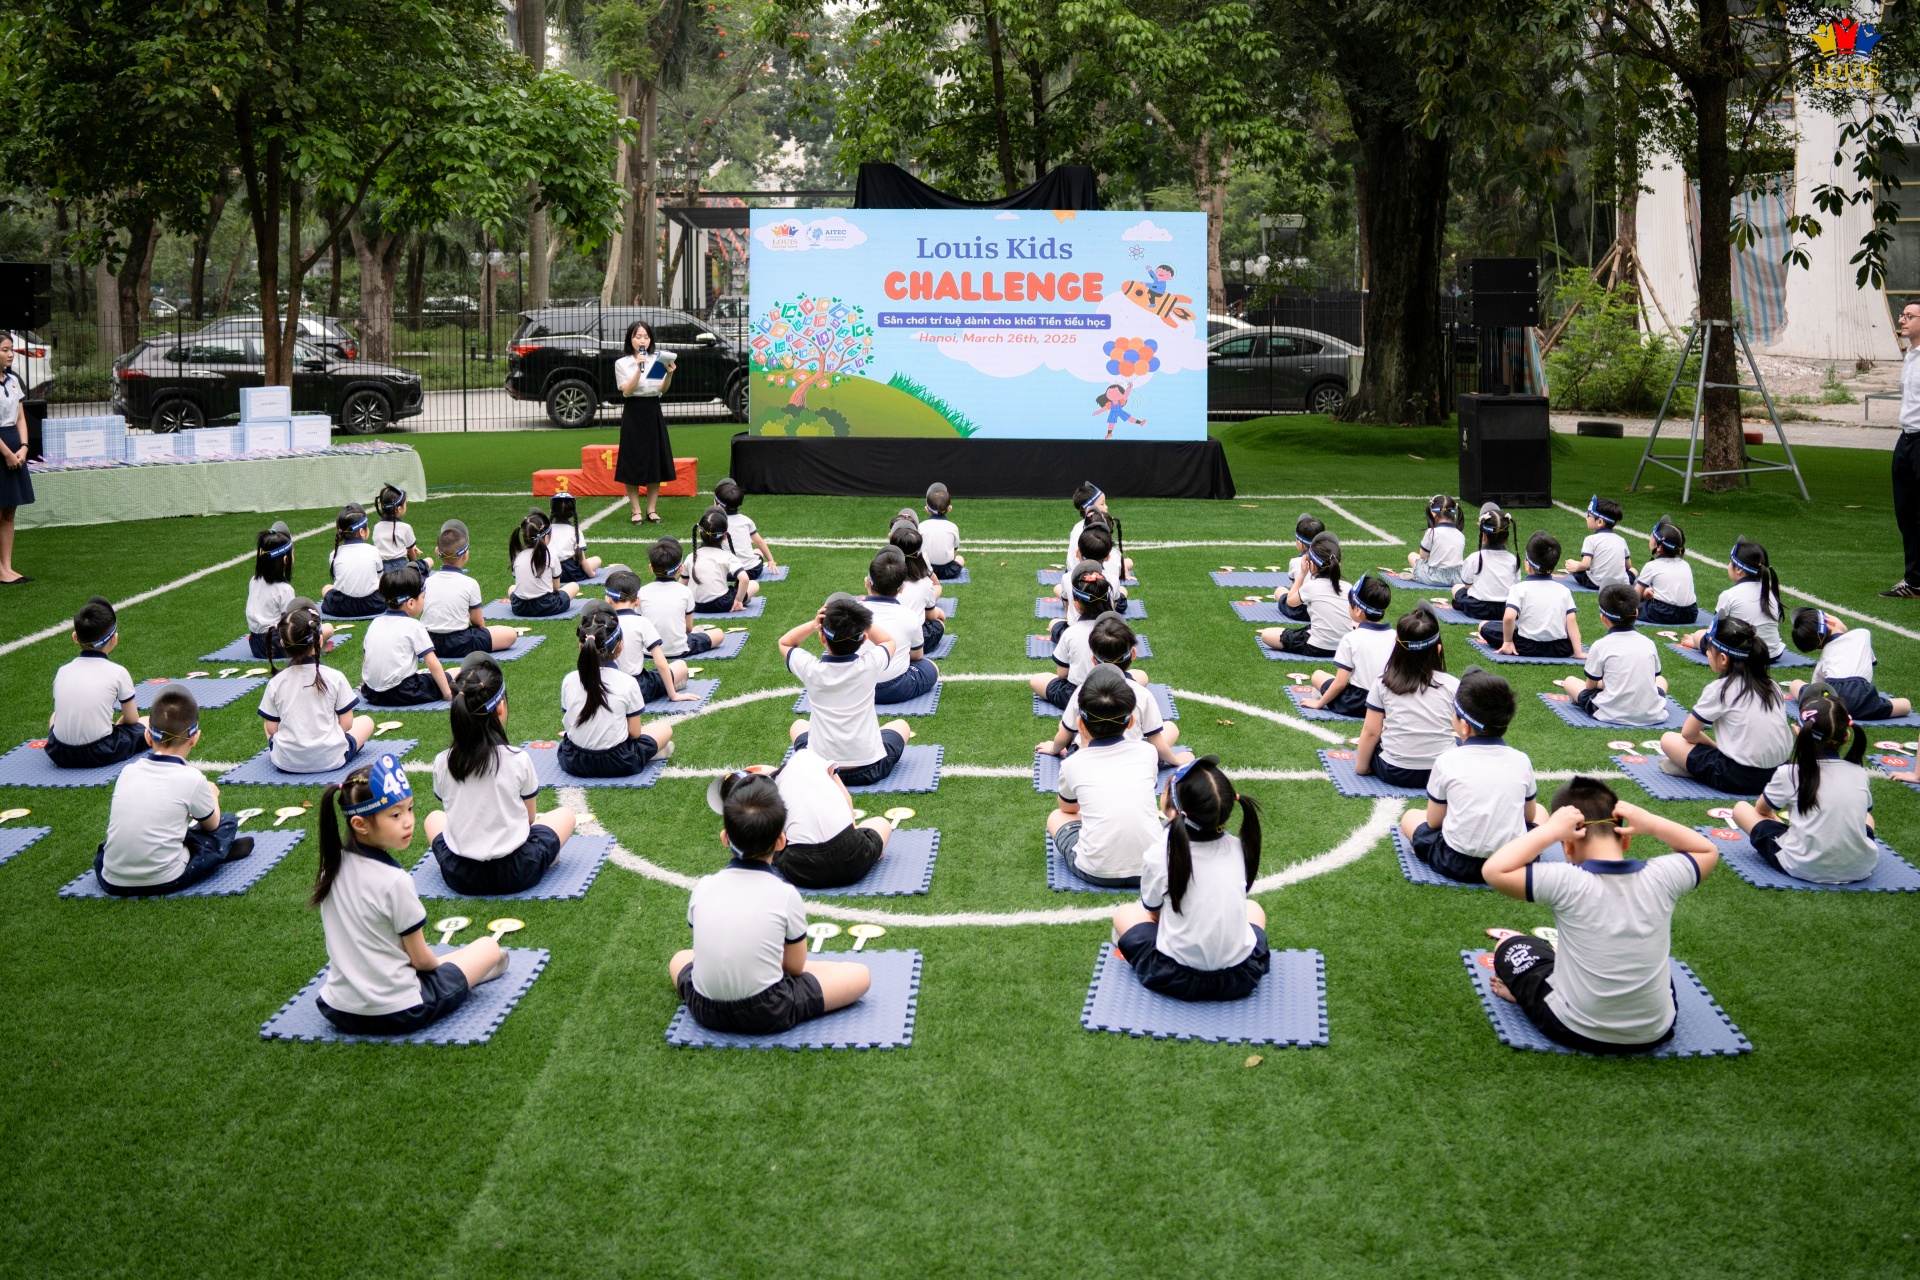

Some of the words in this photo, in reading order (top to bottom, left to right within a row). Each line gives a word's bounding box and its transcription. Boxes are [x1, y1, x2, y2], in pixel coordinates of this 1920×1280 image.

[916, 235, 999, 260] Louis
[1006, 235, 1073, 260] Kids
[884, 270, 1104, 302] CHALLENGE
[883, 315, 903, 325] Sân
[906, 316, 927, 325] chơi
[930, 316, 942, 325] trí
[944, 316, 961, 327] tuệ
[964, 316, 990, 325] dành
[993, 317, 1012, 326] cho
[1087, 317, 1106, 328] học
[919, 333, 959, 344] Hanoi,
[962, 333, 1004, 343] March
[1007, 333, 1040, 344] 26th,
[1043, 333, 1077, 344] 2025
[601, 449, 613, 470] 1
[555, 475, 569, 493] 3
[383, 768, 410, 796] 49
[445, 920, 460, 929] B
[498, 920, 515, 930] C
[815, 926, 829, 935] B
